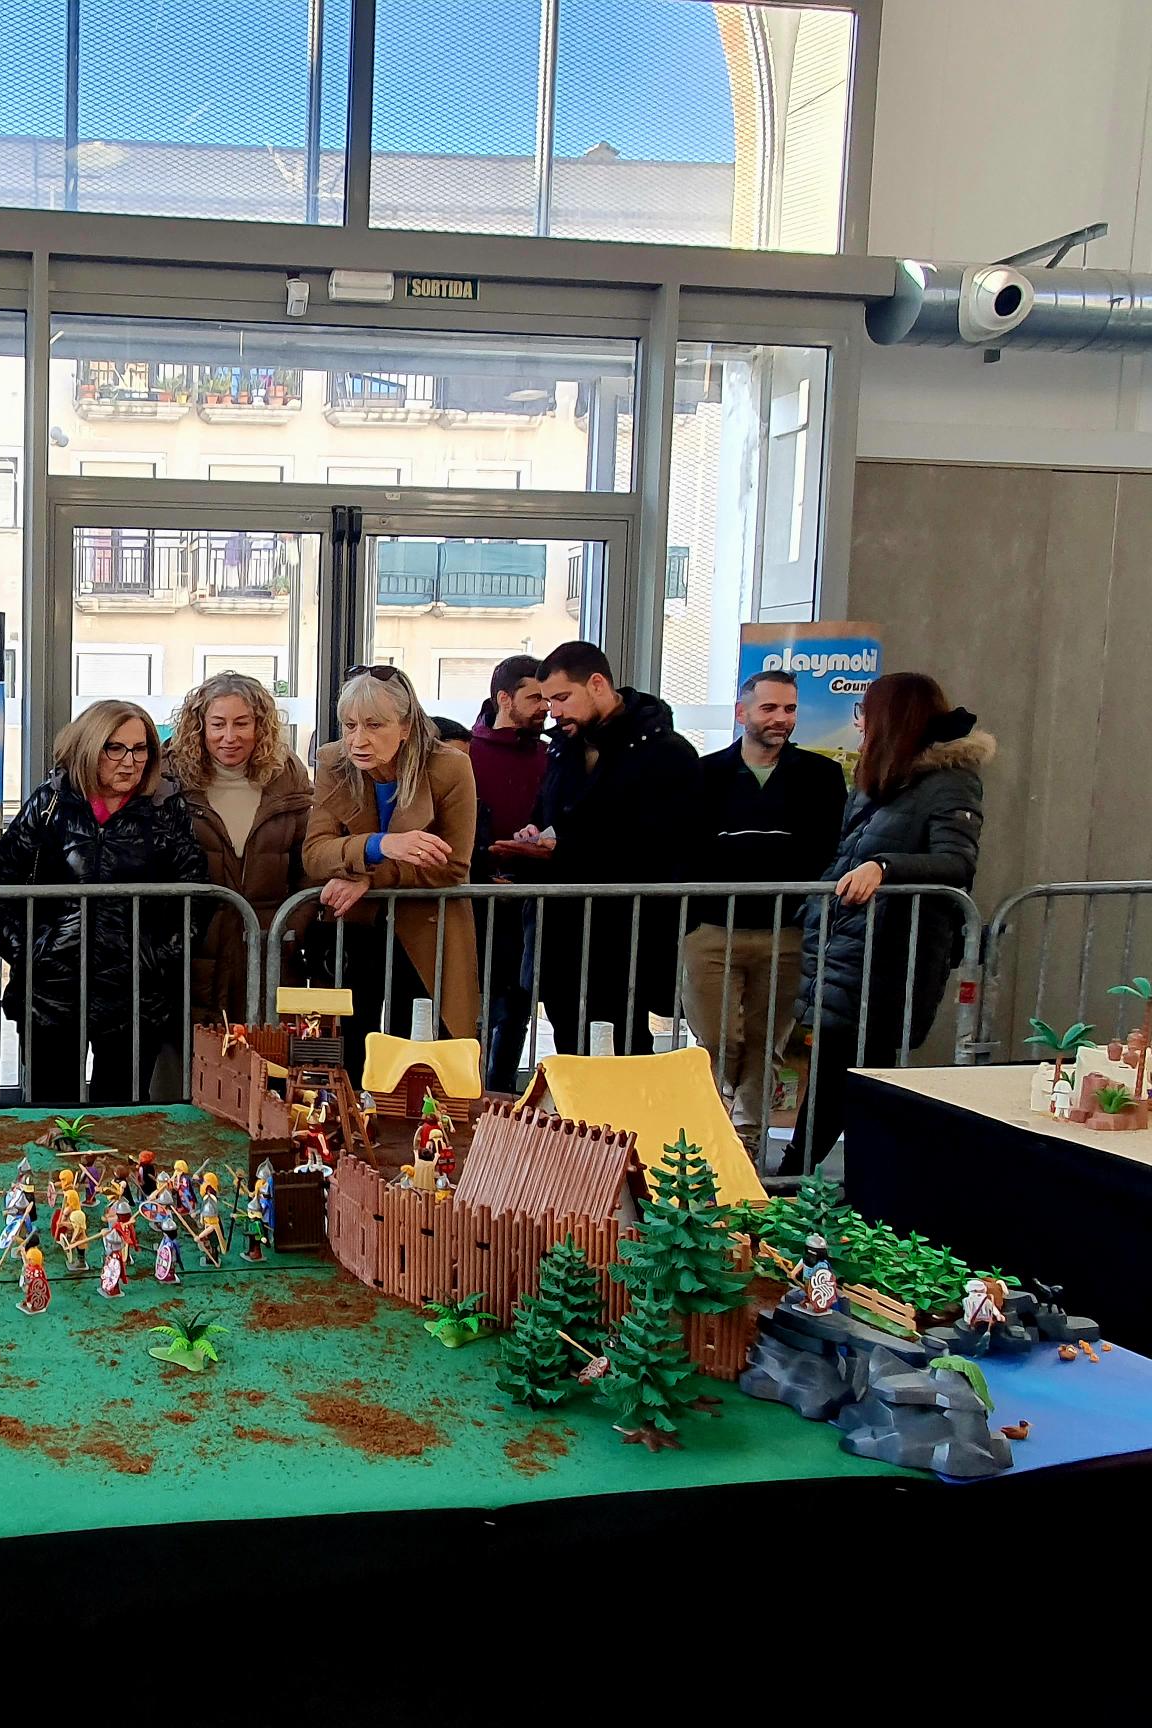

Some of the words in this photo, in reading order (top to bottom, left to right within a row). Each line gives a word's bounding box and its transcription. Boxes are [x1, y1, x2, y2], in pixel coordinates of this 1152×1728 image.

[411, 279, 473, 299] SORTIDA
[762, 647, 878, 677] playmobil
[831, 679, 869, 691] Coun
